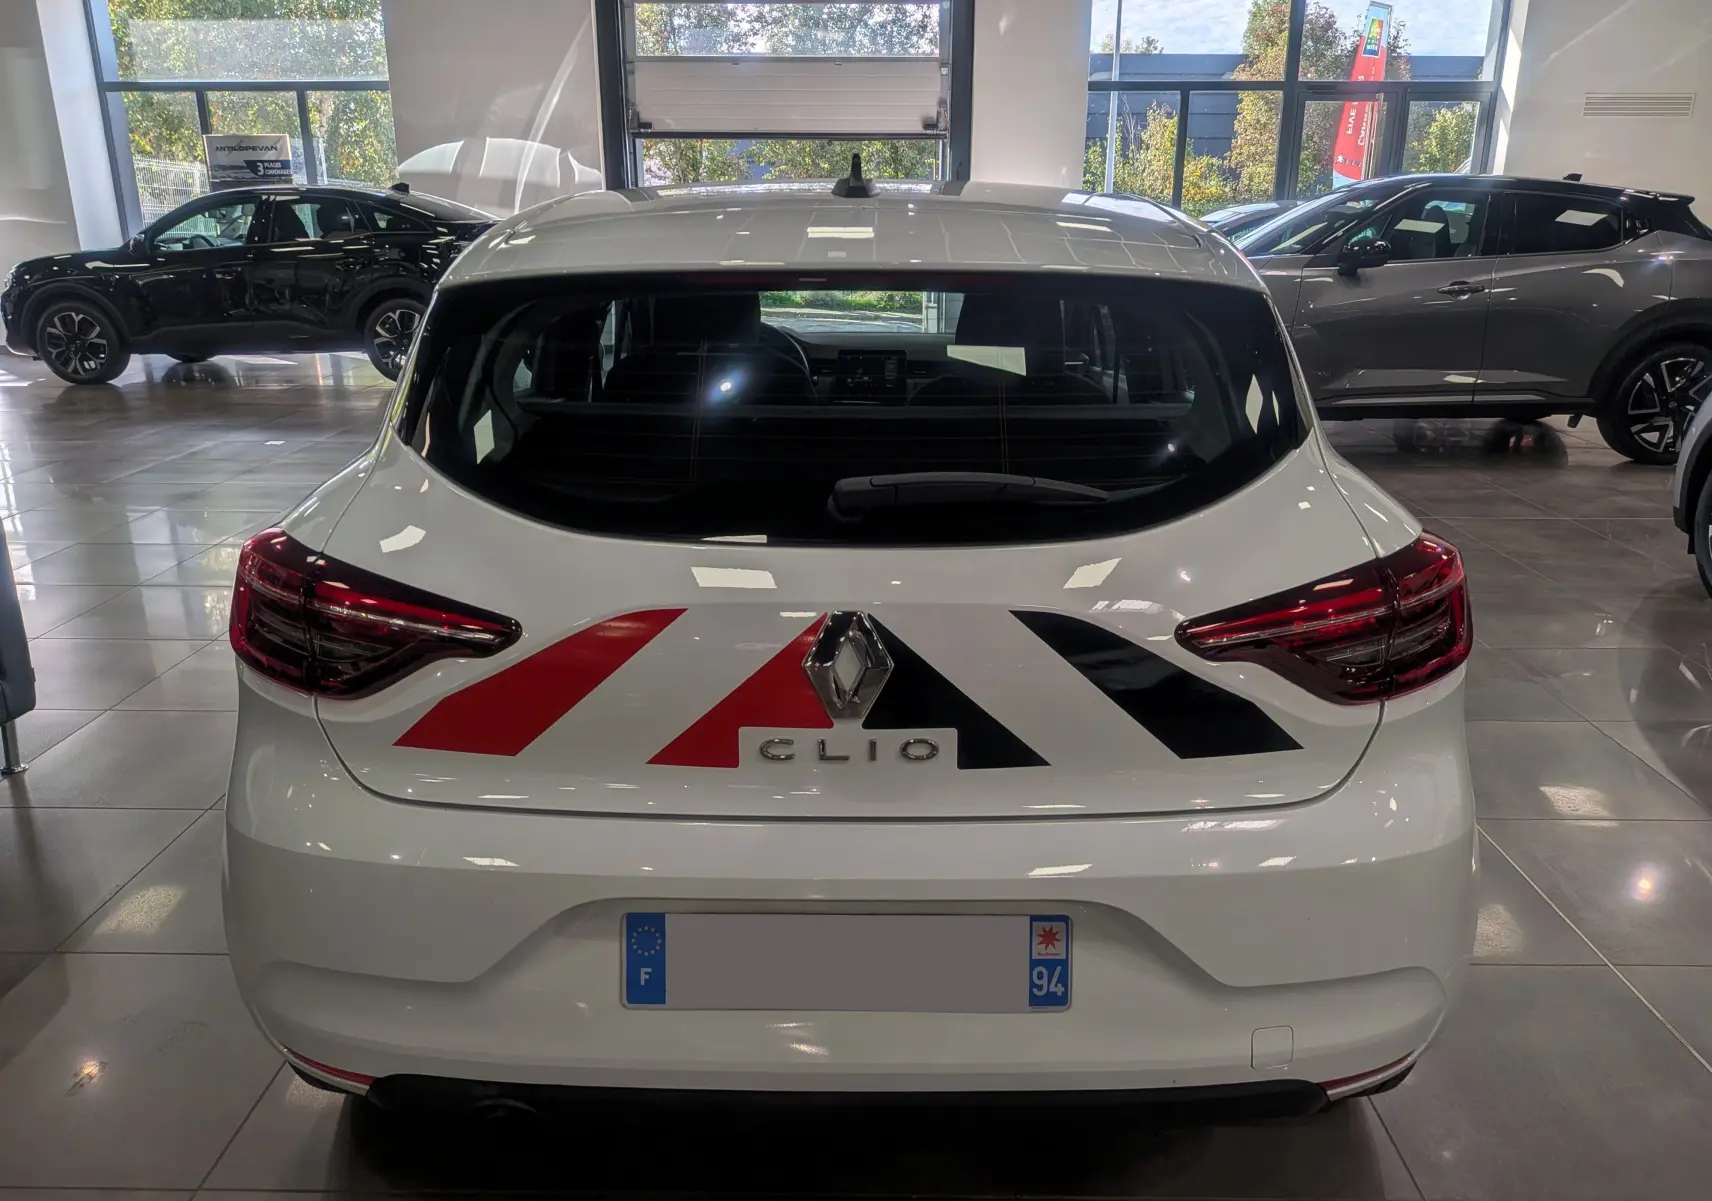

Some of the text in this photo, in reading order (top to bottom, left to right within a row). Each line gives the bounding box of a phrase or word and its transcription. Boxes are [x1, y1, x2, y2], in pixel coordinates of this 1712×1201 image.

[257, 163, 264, 175] 3
[759, 738, 940, 761] CLIO
[640, 967, 652, 986] F
[1032, 966, 1065, 996] 94
